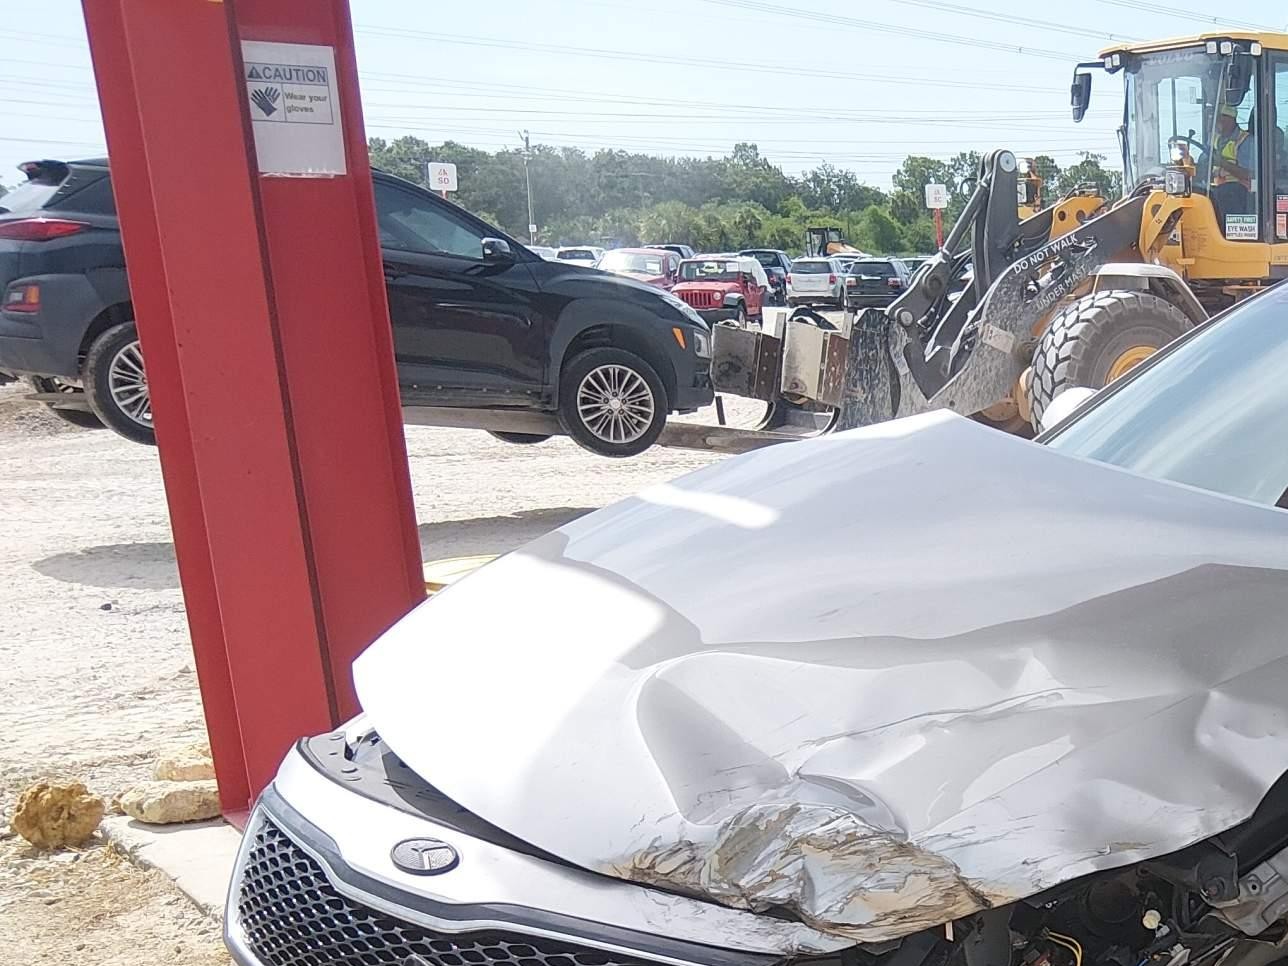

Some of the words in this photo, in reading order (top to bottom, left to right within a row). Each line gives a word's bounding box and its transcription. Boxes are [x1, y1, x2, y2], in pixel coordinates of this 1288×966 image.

[262, 66, 327, 82] CAUTION
[285, 91, 306, 101] Wear
[308, 95, 327, 103] your
[286, 104, 314, 114] gloves
[1014, 260, 1028, 274] DO
[1030, 248, 1049, 265] NOT
[1051, 233, 1078, 254] WALK
[1036, 283, 1065, 309] UNDER
[1064, 264, 1086, 287] MAST
